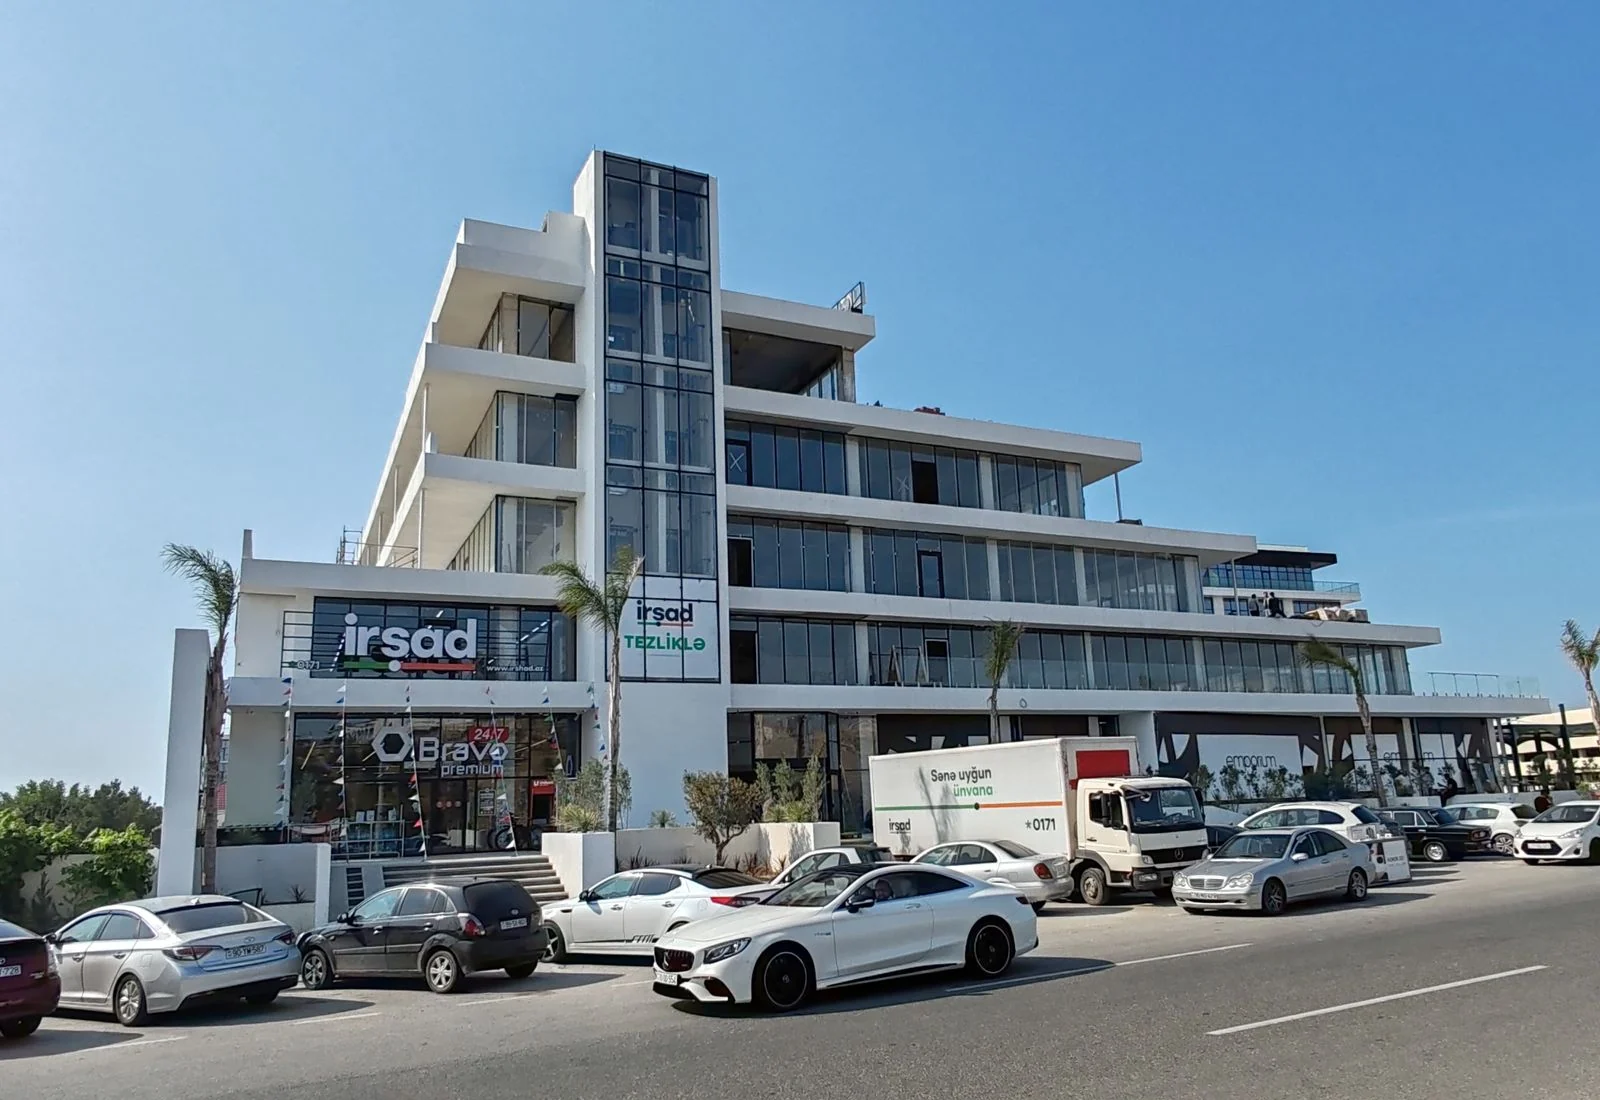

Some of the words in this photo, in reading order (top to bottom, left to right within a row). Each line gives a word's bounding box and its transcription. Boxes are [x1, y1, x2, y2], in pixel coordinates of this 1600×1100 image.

[418, 736, 509, 762] Bravo
[440, 763, 504, 778] premium
[930, 768, 957, 783] Sənə
[958, 766, 992, 784] uyğun
[953, 783, 994, 798] ünvana
